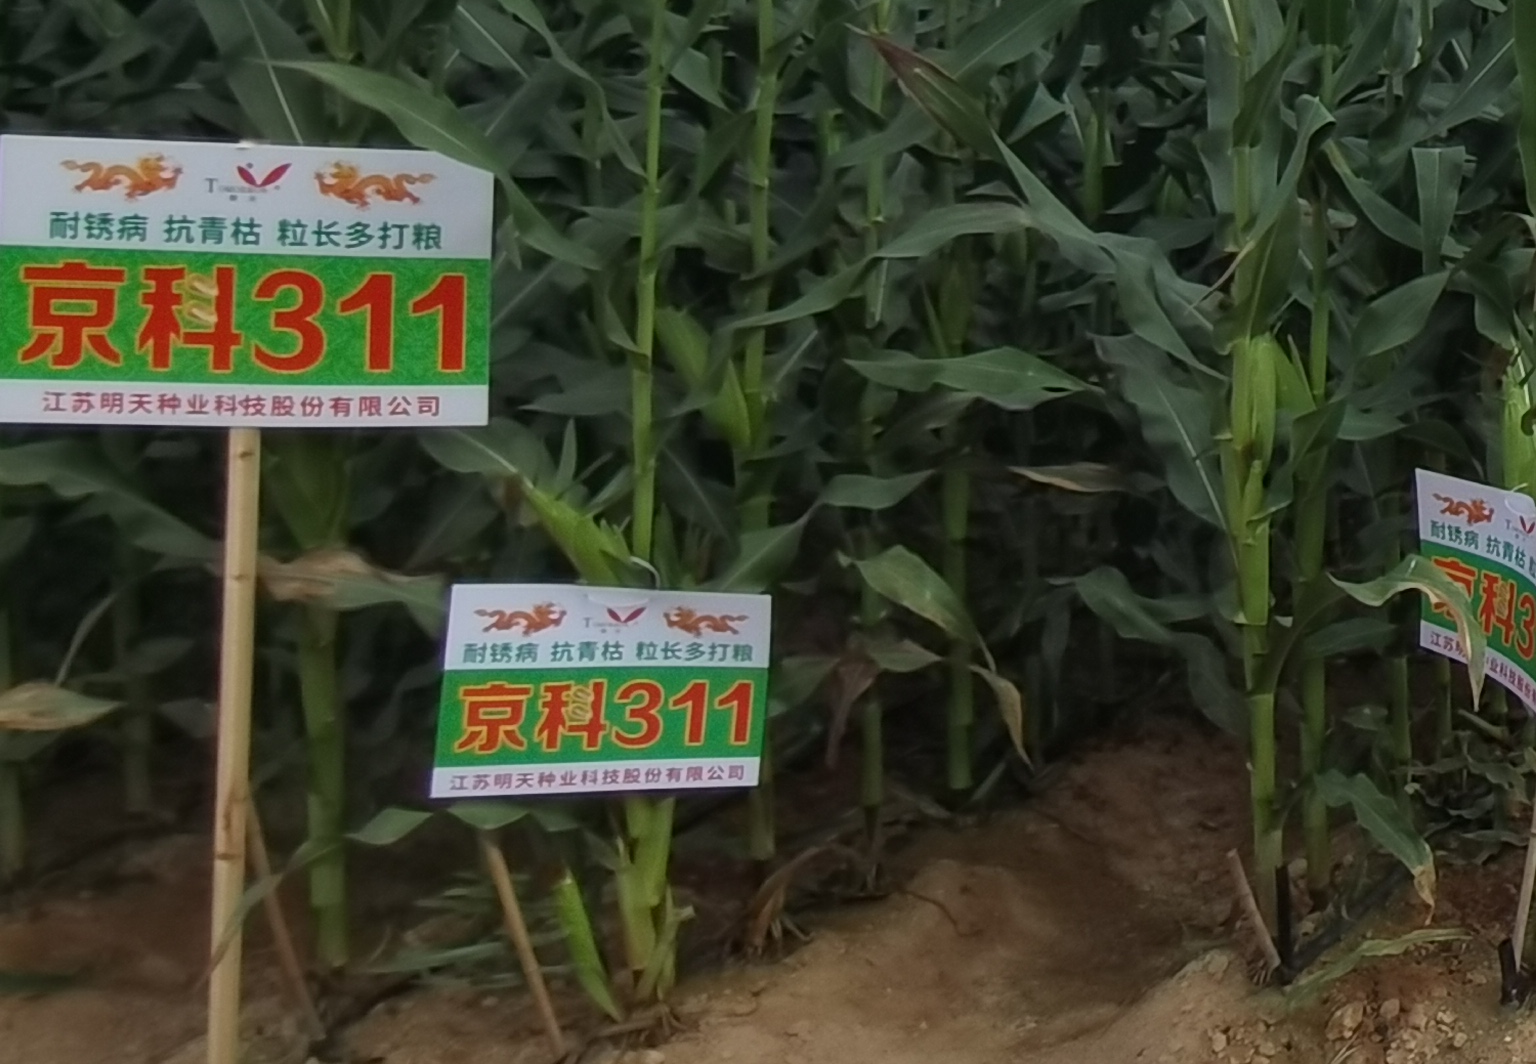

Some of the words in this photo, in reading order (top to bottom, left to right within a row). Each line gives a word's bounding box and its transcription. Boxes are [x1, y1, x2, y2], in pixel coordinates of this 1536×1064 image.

[49, 211, 148, 242] 耐锈病
[163, 214, 262, 246] 抗青枯
[276, 219, 443, 252] 粒长多打粮
[18, 260, 468, 374] 京科311
[42, 391, 442, 418] 江苏明天种业科技股份有限公司
[1430, 520, 1480, 550] 耐锈病
[1486, 534, 1526, 569] 抗青枯
[462, 641, 540, 664] 耐锈病
[550, 641, 625, 663] 抗青枯
[636, 641, 754, 663] 粒长多打粮
[454, 678, 755, 755] 京科311
[449, 764, 745, 792] 江苏明天种业科技股份有限公司
